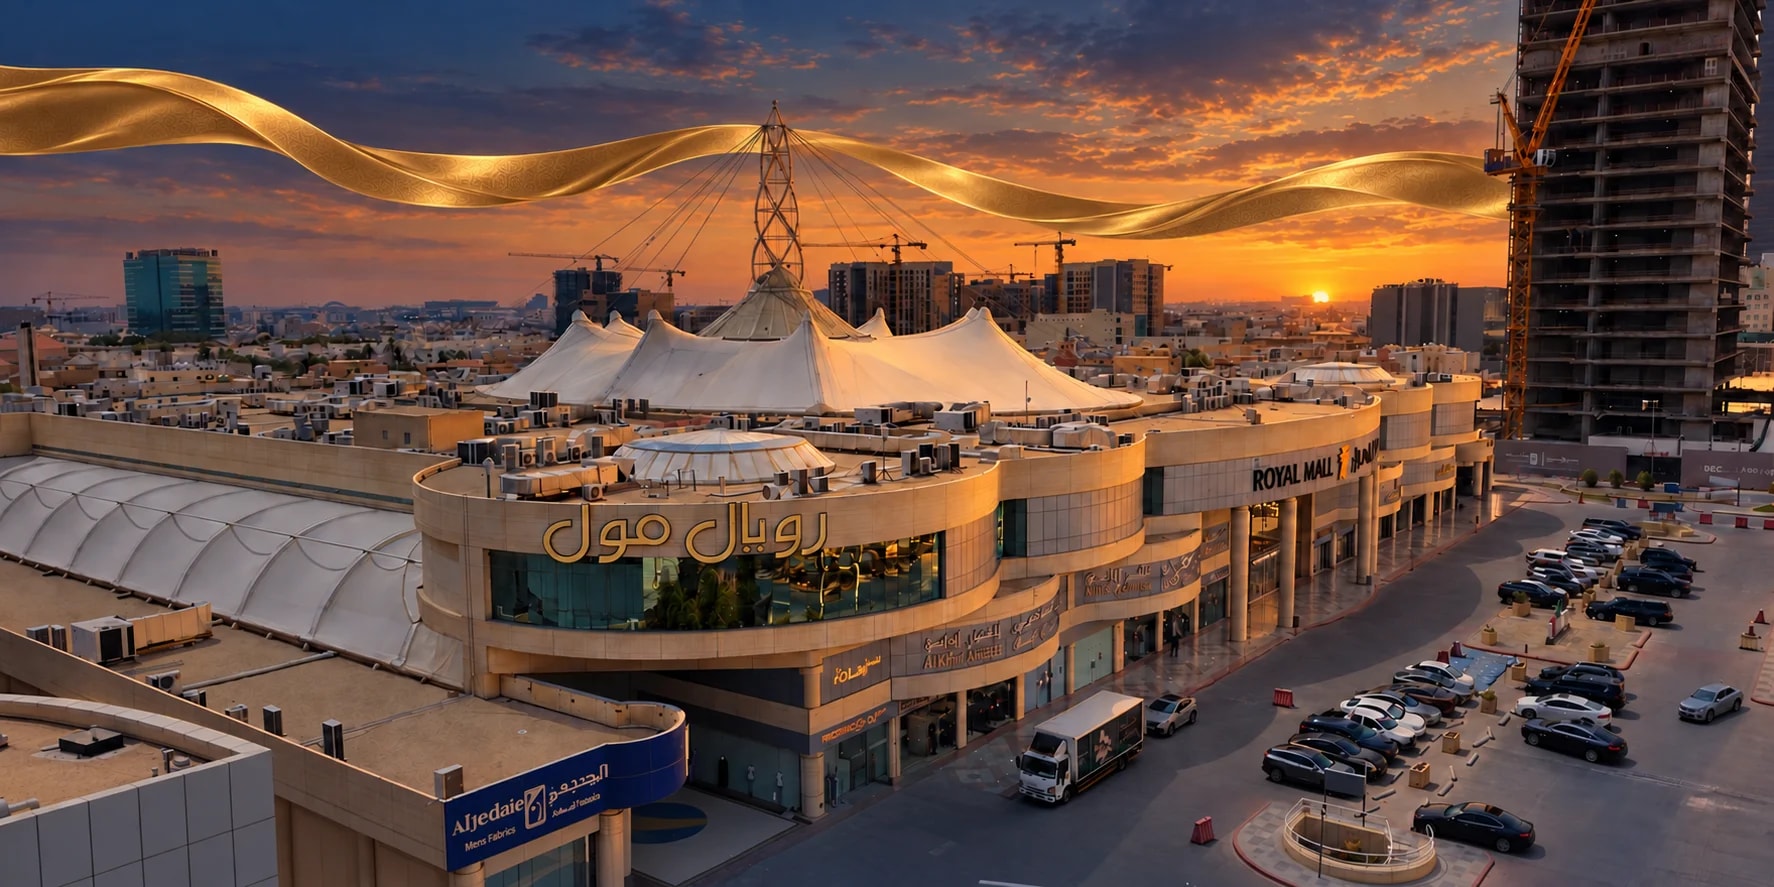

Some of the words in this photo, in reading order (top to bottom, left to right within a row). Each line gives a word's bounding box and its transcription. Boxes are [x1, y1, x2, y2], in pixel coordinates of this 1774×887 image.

[1253, 463, 1300, 492] ROYAL
[1304, 456, 1333, 481] MALL
[542, 502, 672, 564] مول
[685, 501, 828, 564] رويال
[452, 798, 525, 837] Aljedaie
[465, 837, 487, 852] Mens
[488, 826, 517, 843] Fabrics
